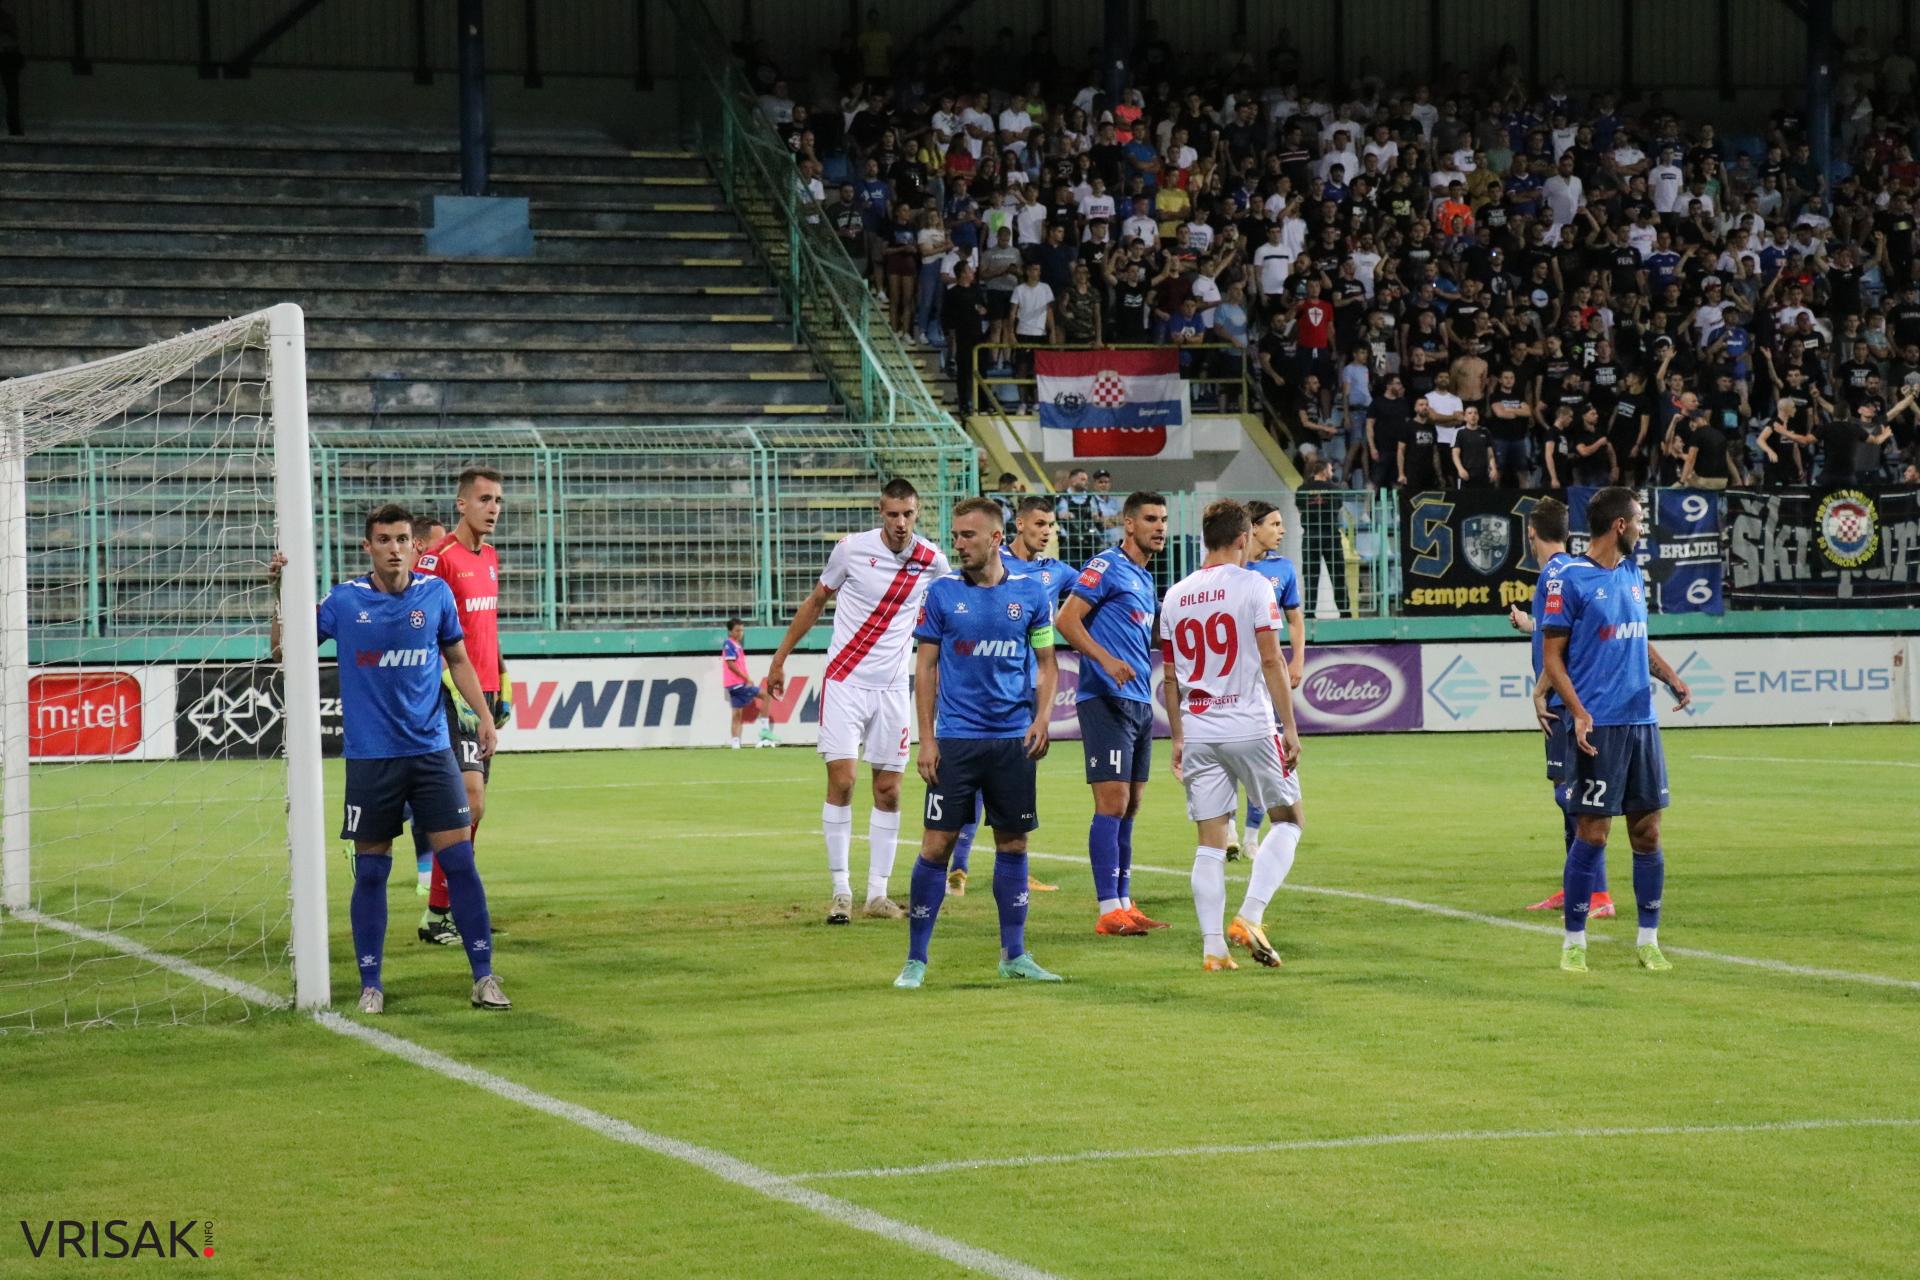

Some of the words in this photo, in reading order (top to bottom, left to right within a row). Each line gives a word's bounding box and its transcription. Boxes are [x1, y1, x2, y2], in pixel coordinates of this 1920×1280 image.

[1682, 495, 1709, 522] 9
[1659, 541, 1718, 559] BRIJEG
[1179, 589, 1226, 608] BILBIJA
[1686, 578, 1713, 605] 6
[355, 648, 429, 669] WWIN
[954, 639, 1018, 657] WWIN
[1174, 611, 1239, 682] 99
[1313, 676, 1381, 702] Violeta
[1734, 667, 1891, 695] EMERUS
[37, 694, 129, 730] m:tel
[460, 740, 480, 764] 12
[1109, 749, 1122, 775] 4
[926, 792, 944, 821] 15
[1581, 778, 1607, 808] 22
[346, 804, 362, 832] 17
